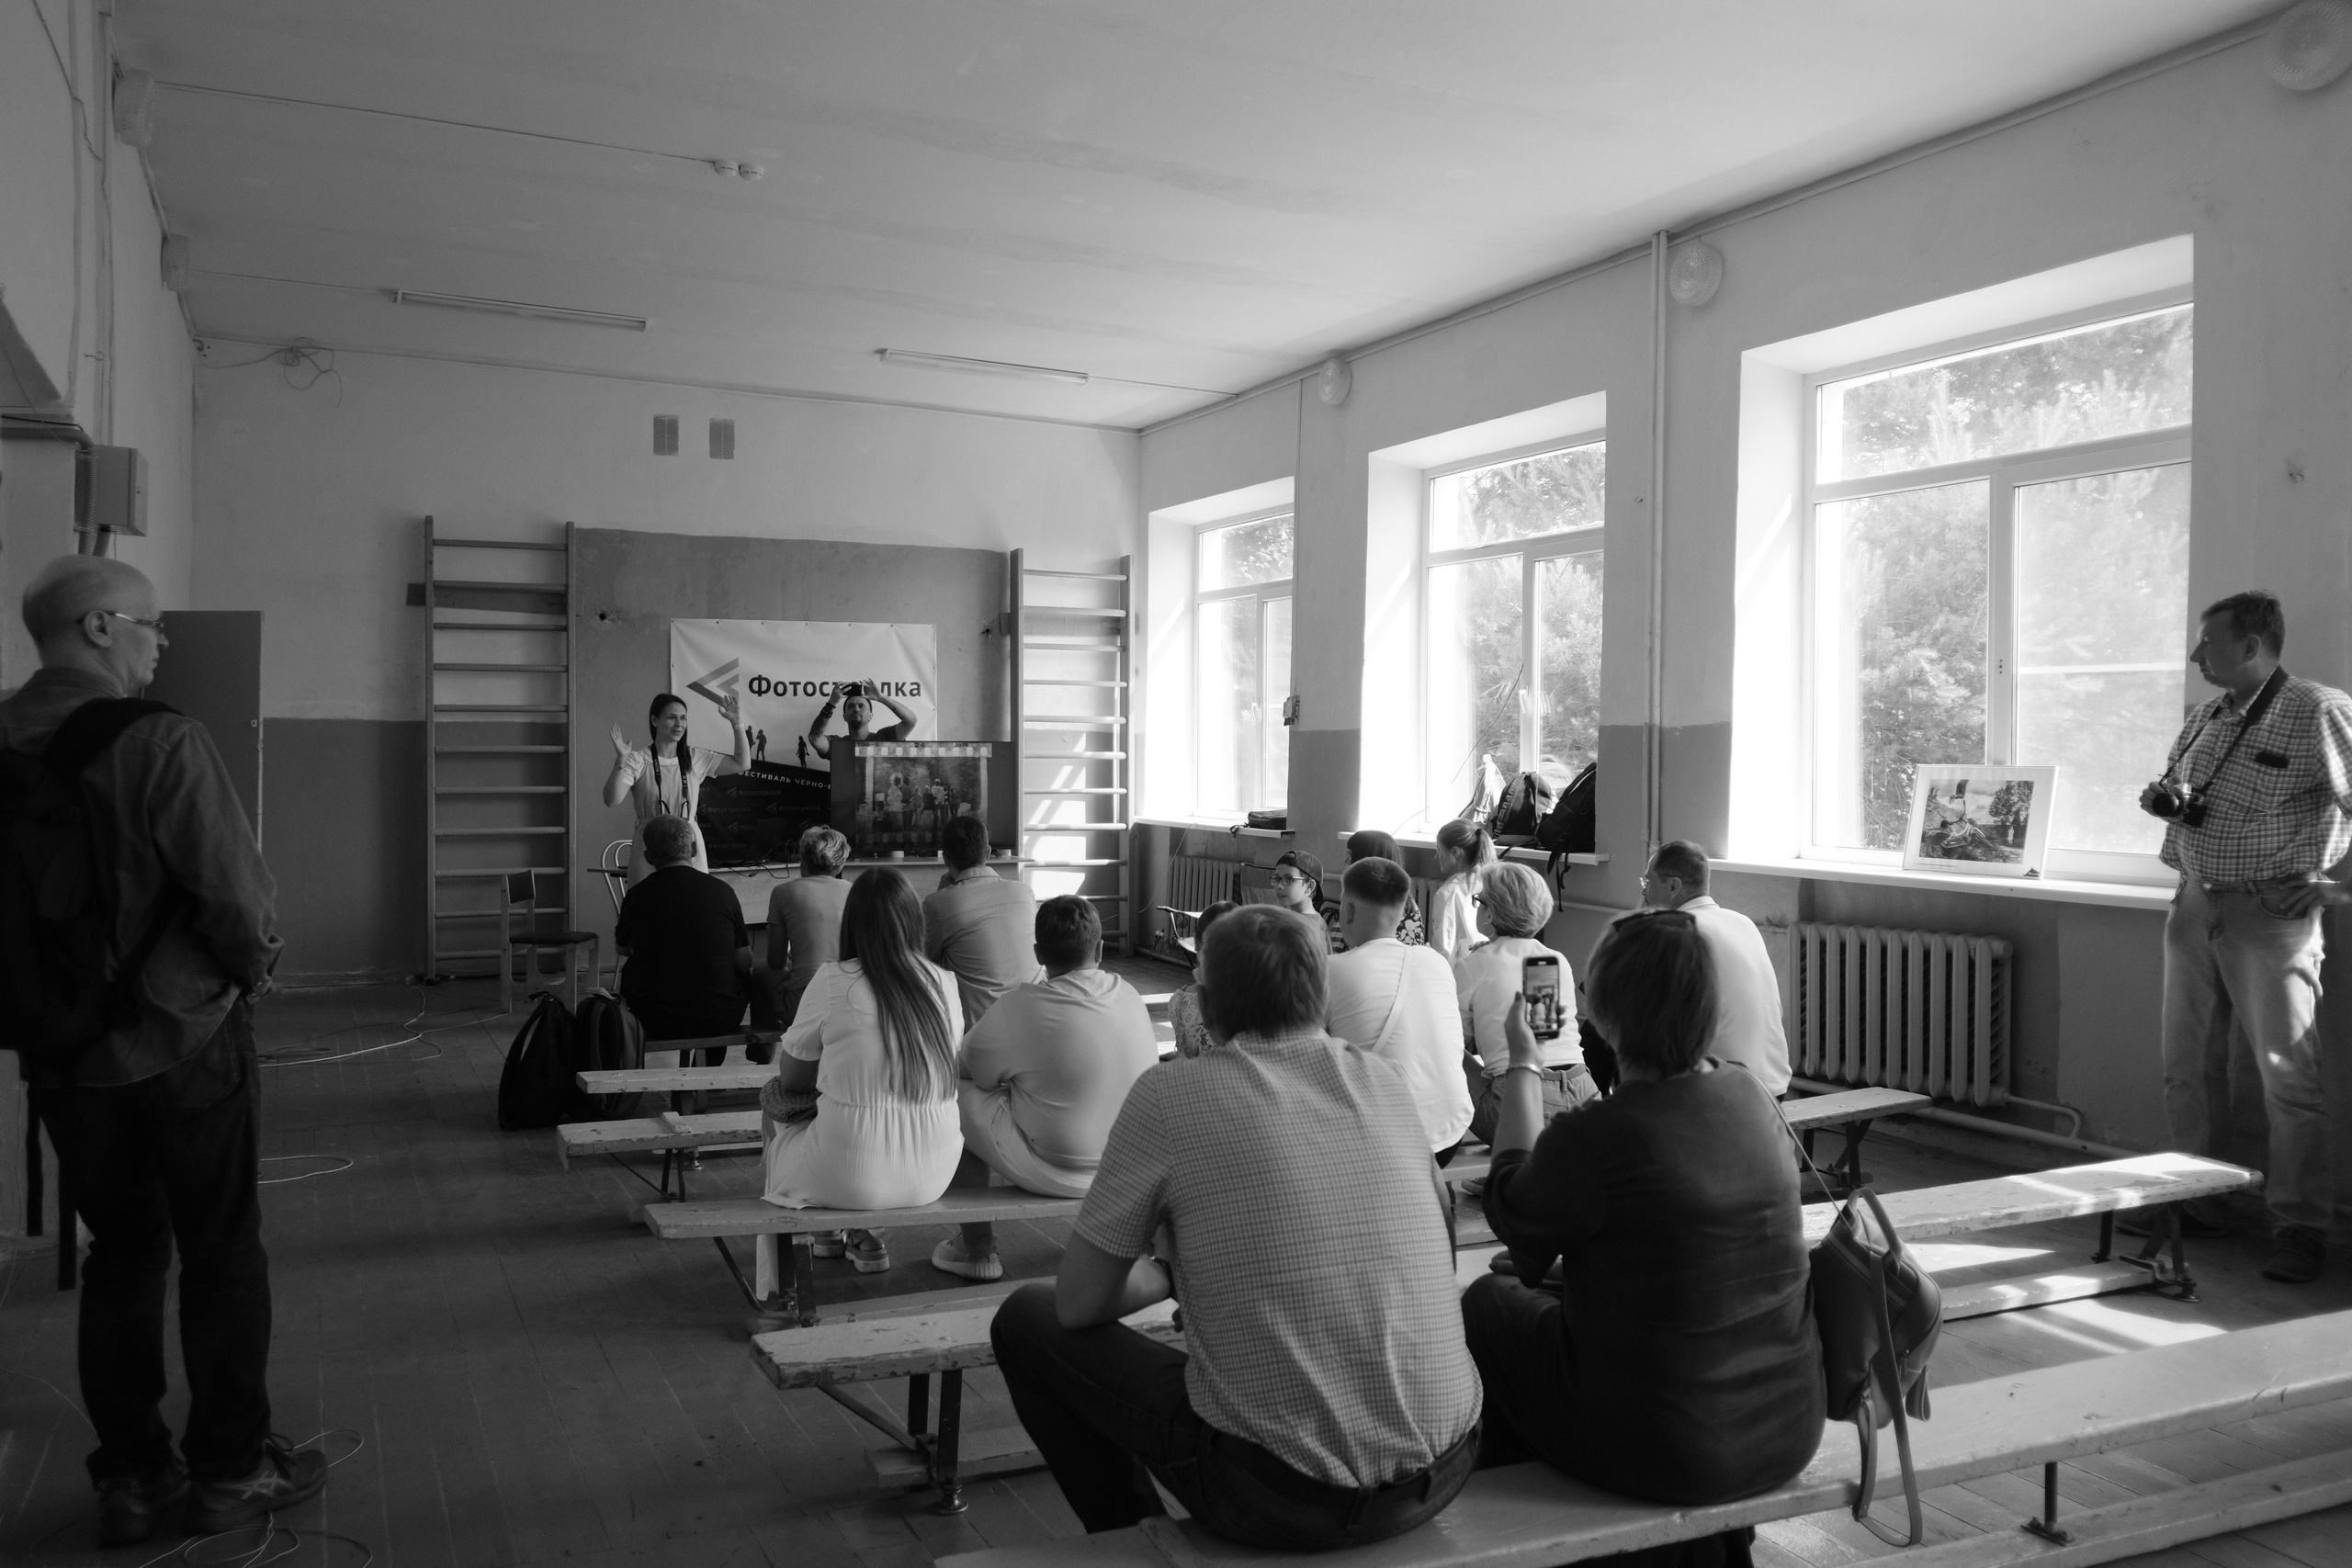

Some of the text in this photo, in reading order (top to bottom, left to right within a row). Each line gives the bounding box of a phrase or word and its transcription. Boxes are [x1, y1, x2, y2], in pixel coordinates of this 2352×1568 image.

[748, 674, 922, 697] Фотослка
[737, 771, 791, 783] ФЕСТИВАЛЬ
[778, 805, 820, 813] Фотострелка
